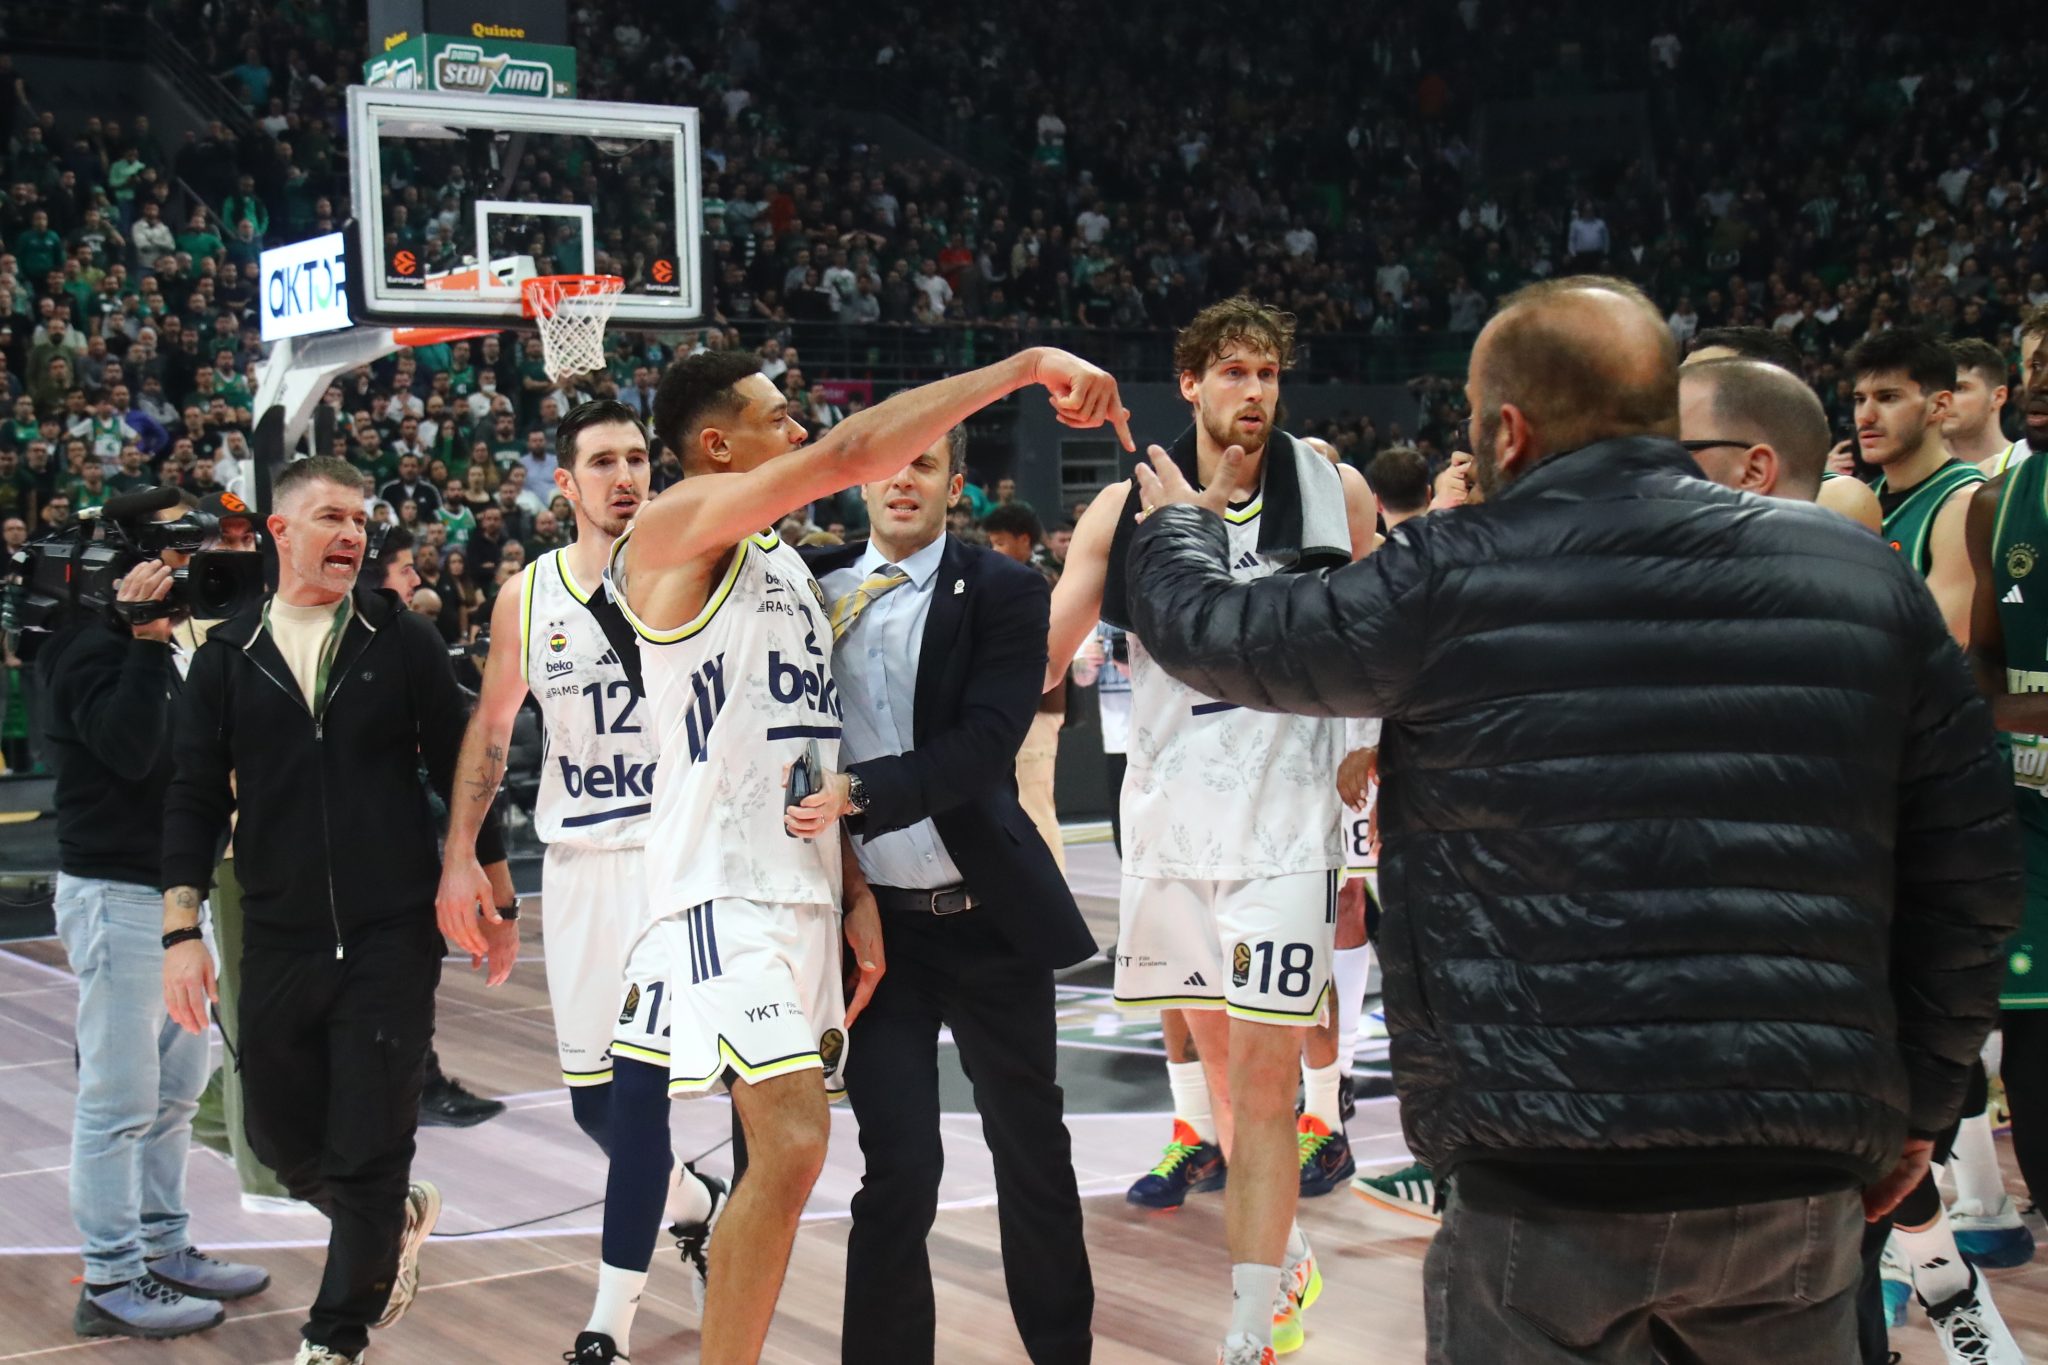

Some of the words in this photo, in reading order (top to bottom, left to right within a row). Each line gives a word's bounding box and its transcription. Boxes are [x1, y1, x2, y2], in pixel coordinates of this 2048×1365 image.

[471, 22, 526, 39] Quince
[546, 660, 574, 673] beko
[768, 651, 844, 722] bek
[582, 680, 642, 735] 12
[1117, 954, 1133, 968] KT
[1255, 940, 1315, 998] 18
[646, 980, 671, 1038] 1
[744, 1003, 780, 1023] YKT
